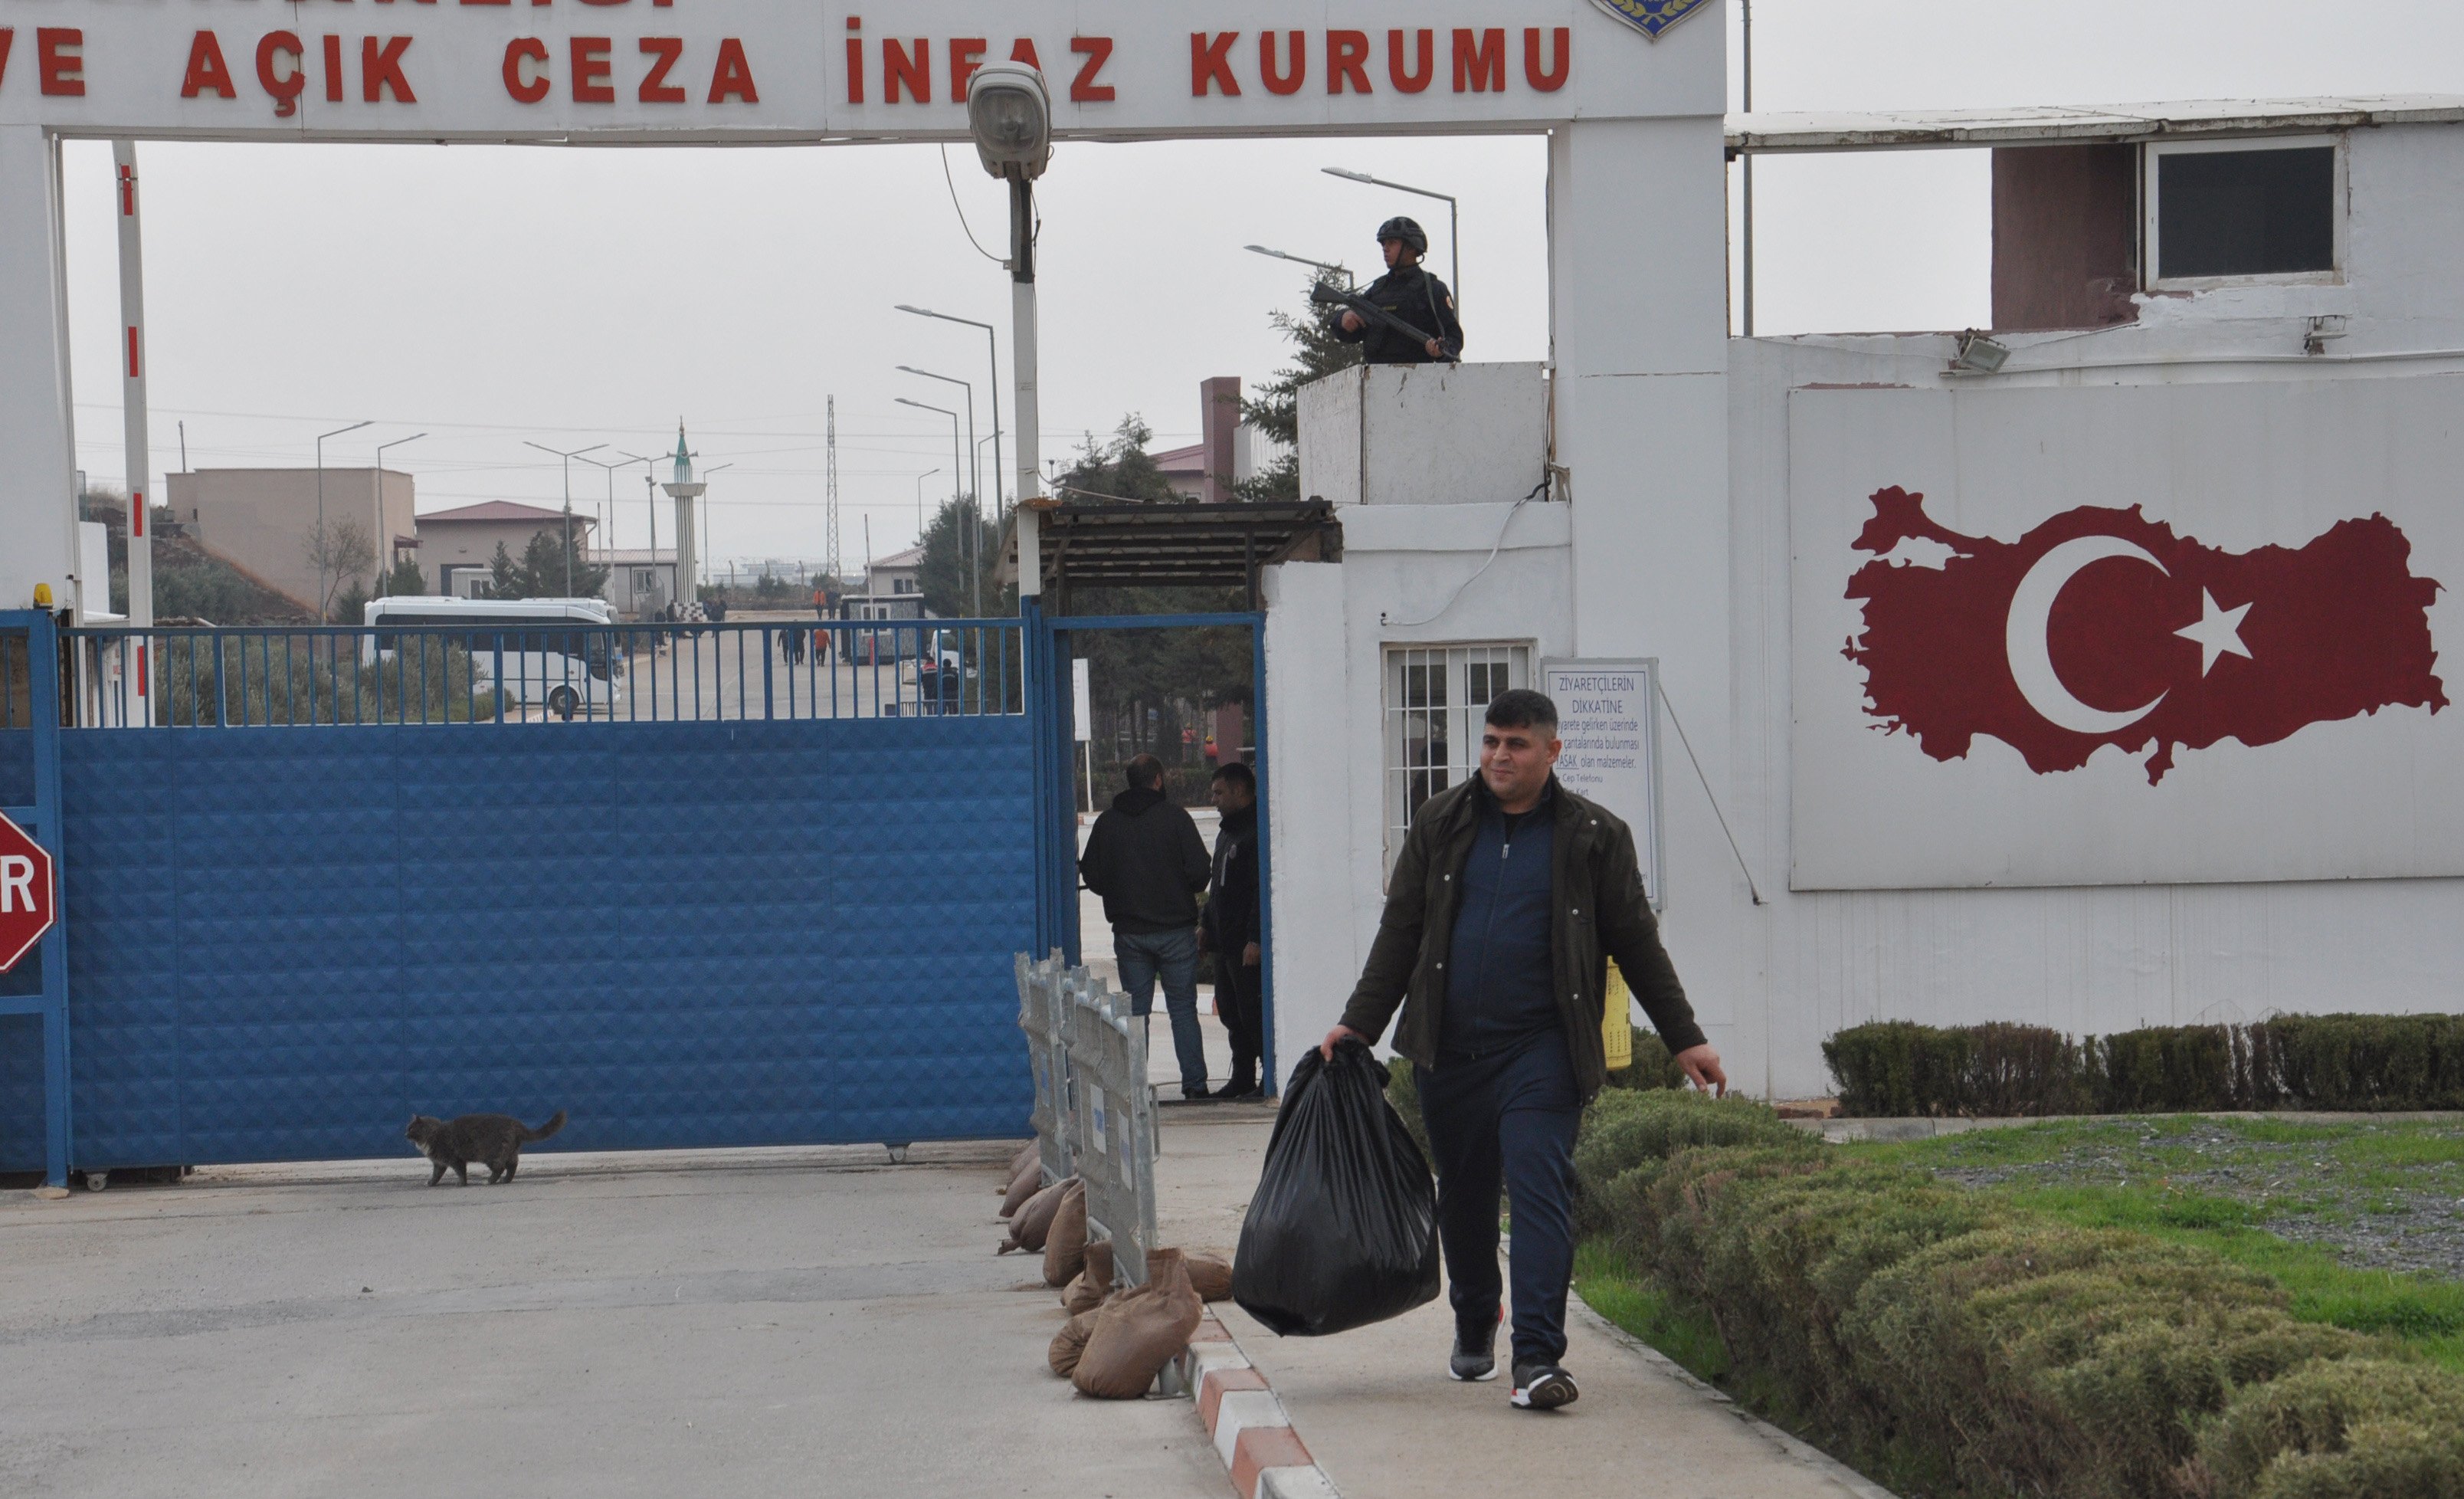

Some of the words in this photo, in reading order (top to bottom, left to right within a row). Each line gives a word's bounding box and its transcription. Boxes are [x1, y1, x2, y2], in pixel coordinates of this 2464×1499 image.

[182, 31, 416, 116] AÇIK
[503, 38, 758, 102] CEZA
[1192, 28, 1569, 95] KURUMU
[1559, 675, 1634, 694] ZİYARETÇİLERİN
[1572, 697, 1623, 713] DİKKATİNE
[1556, 719, 1580, 733] iyarete
[1581, 718, 1607, 733] gelirken
[1610, 717, 1638, 731] üzerinde
[1581, 755, 1594, 767] olan
